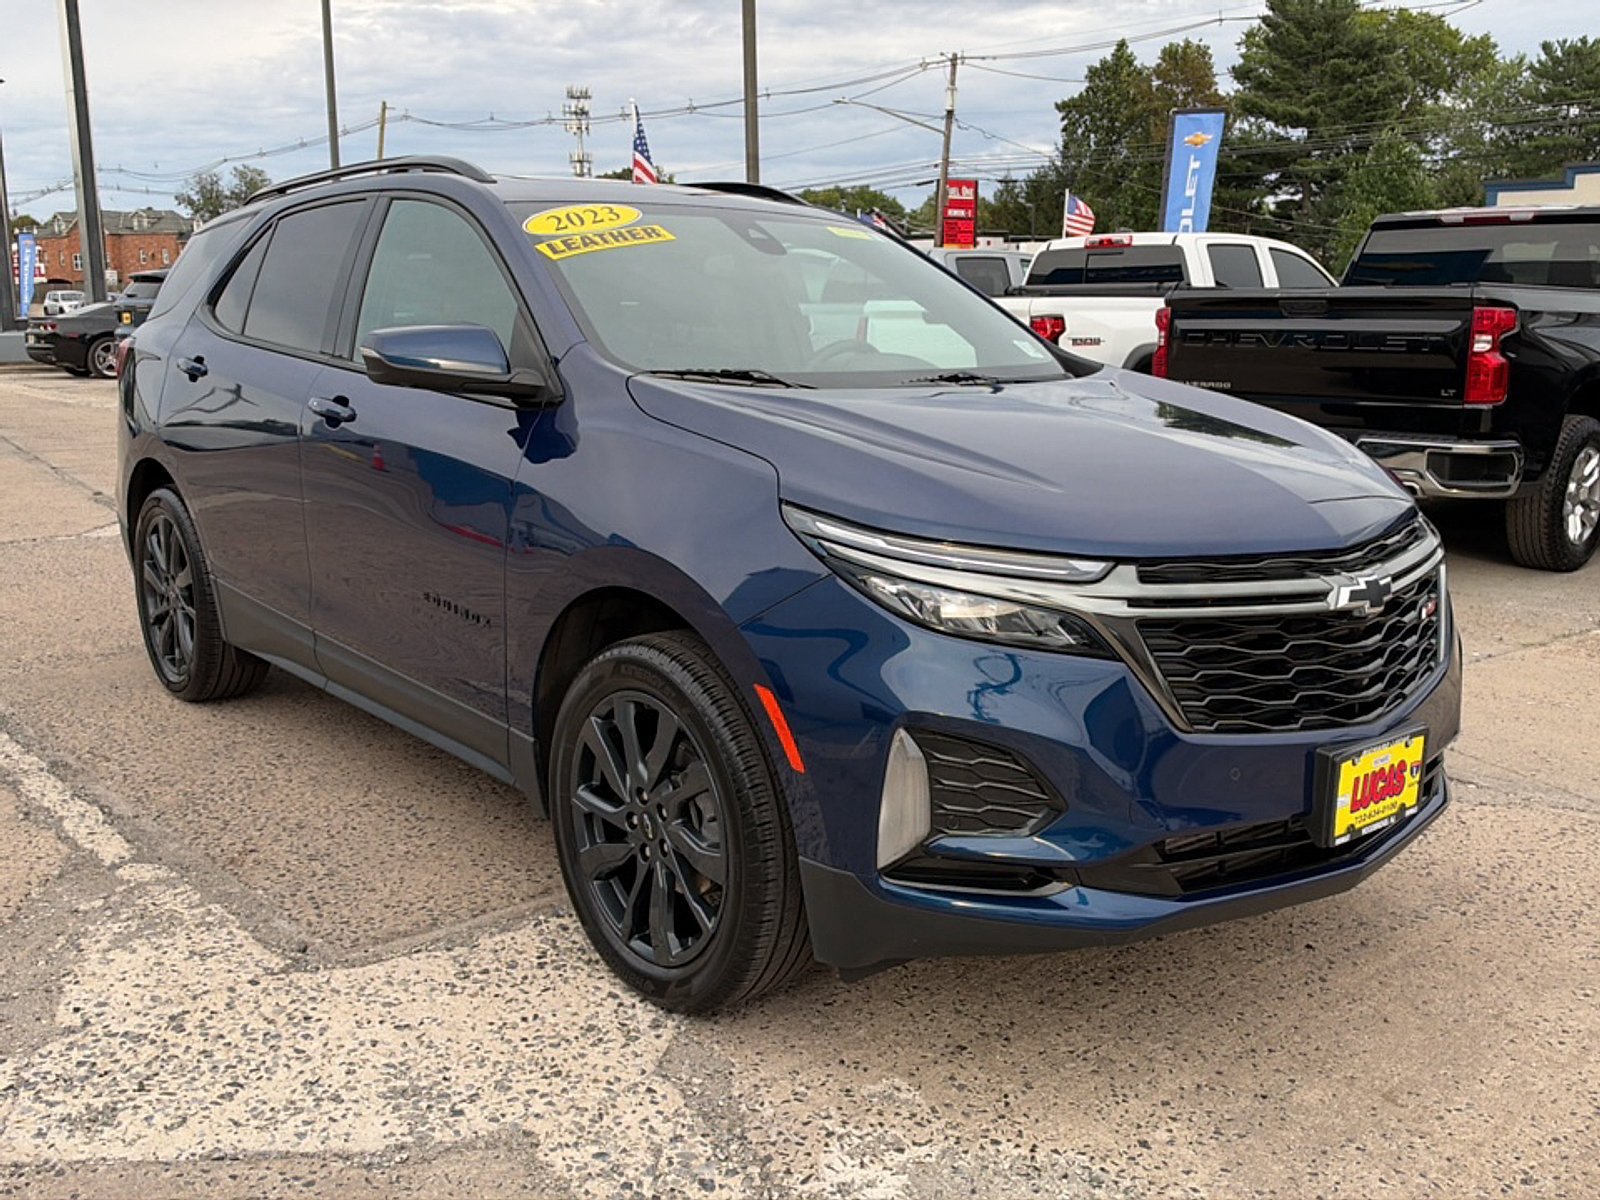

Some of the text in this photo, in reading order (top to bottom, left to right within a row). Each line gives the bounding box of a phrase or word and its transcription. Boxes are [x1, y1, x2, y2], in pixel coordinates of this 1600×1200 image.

[546, 206, 621, 232] 2023
[546, 226, 662, 255] LEATHER
[1183, 333, 1444, 351] CHEVROLET
[1440, 388, 1456, 397] LT
[1350, 759, 1407, 814] LUCAS
